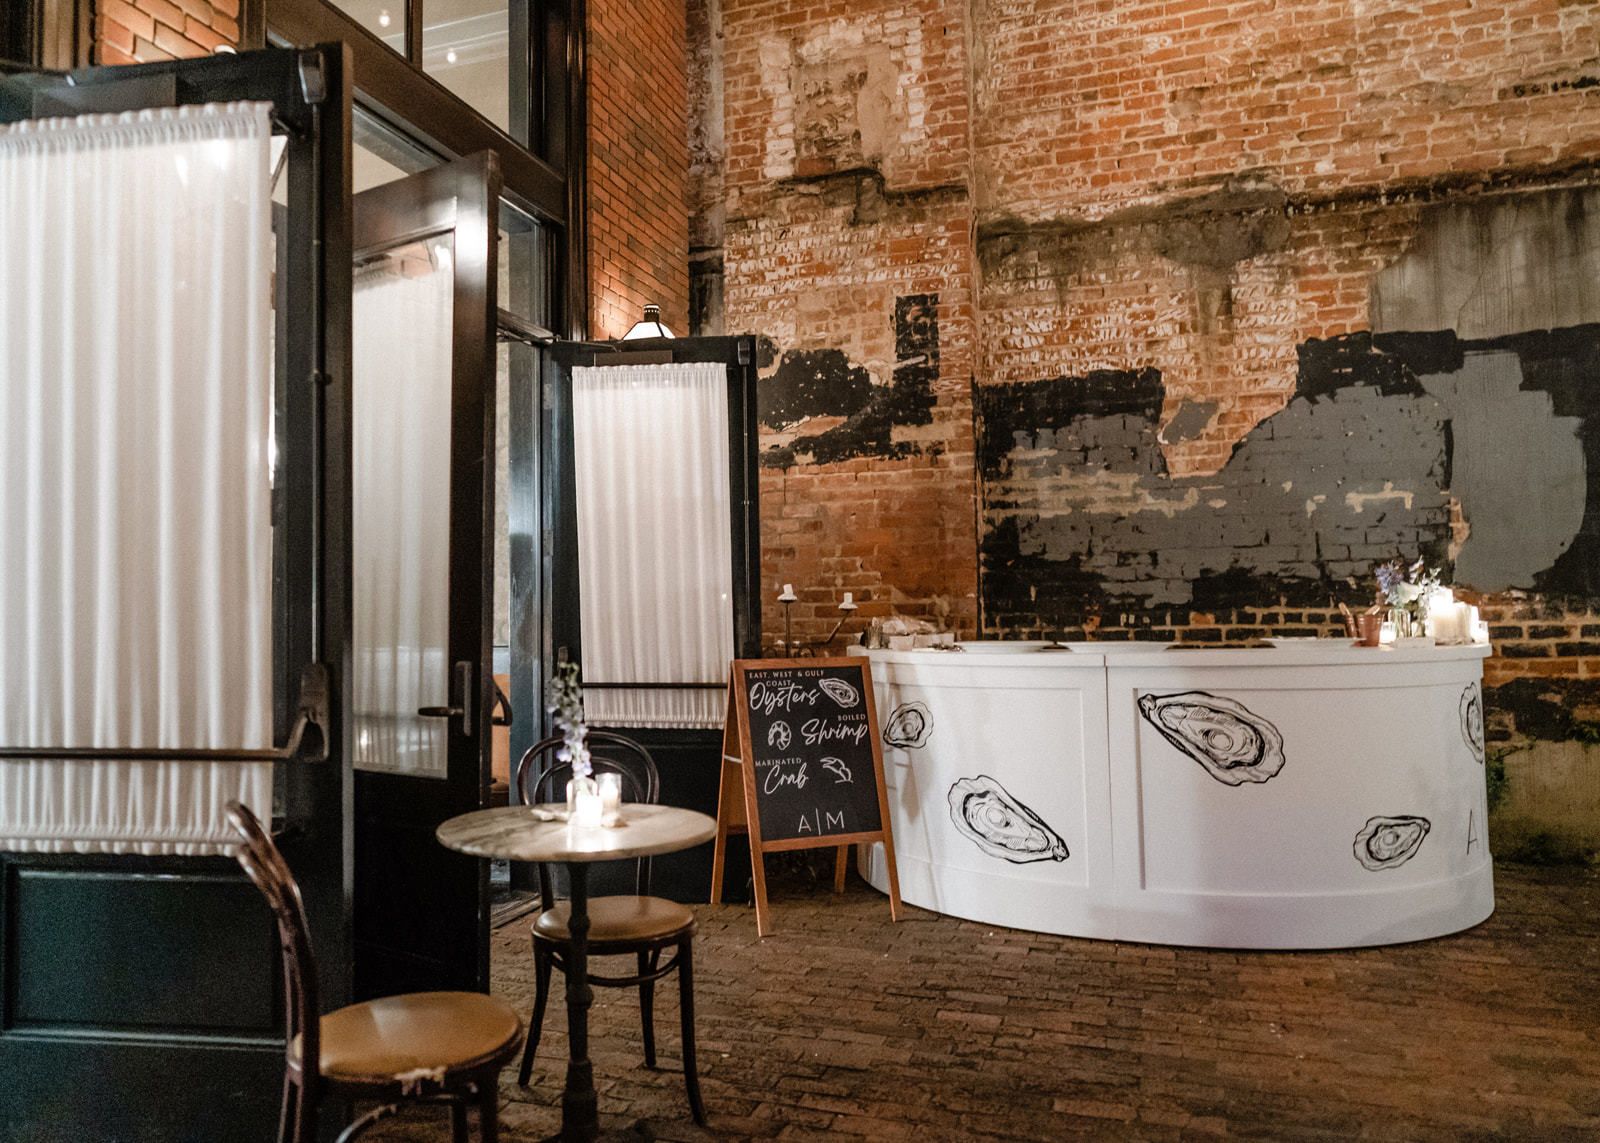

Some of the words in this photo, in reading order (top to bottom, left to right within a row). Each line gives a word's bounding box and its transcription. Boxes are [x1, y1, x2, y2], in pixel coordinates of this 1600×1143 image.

[749, 682, 820, 716] Oysters
[801, 718, 868, 746] Shrimp
[755, 757, 802, 767] MARINATED
[764, 762, 809, 794] Crab
